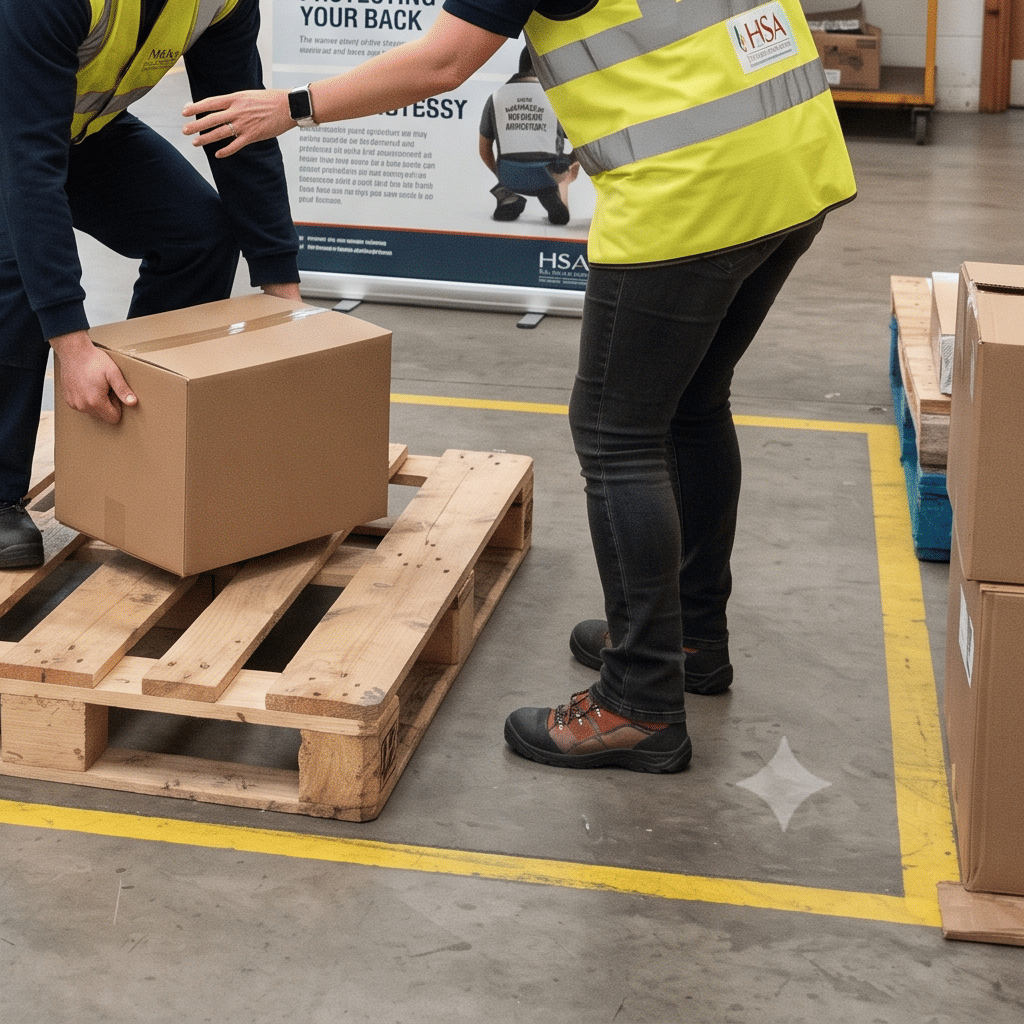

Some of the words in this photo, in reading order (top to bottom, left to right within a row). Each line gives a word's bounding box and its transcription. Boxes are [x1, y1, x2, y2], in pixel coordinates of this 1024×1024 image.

[300, 6, 358, 28] YOUR
[364, 8, 423, 31] BACK
[744, 12, 787, 49] HSA
[539, 251, 590, 272] HSA
